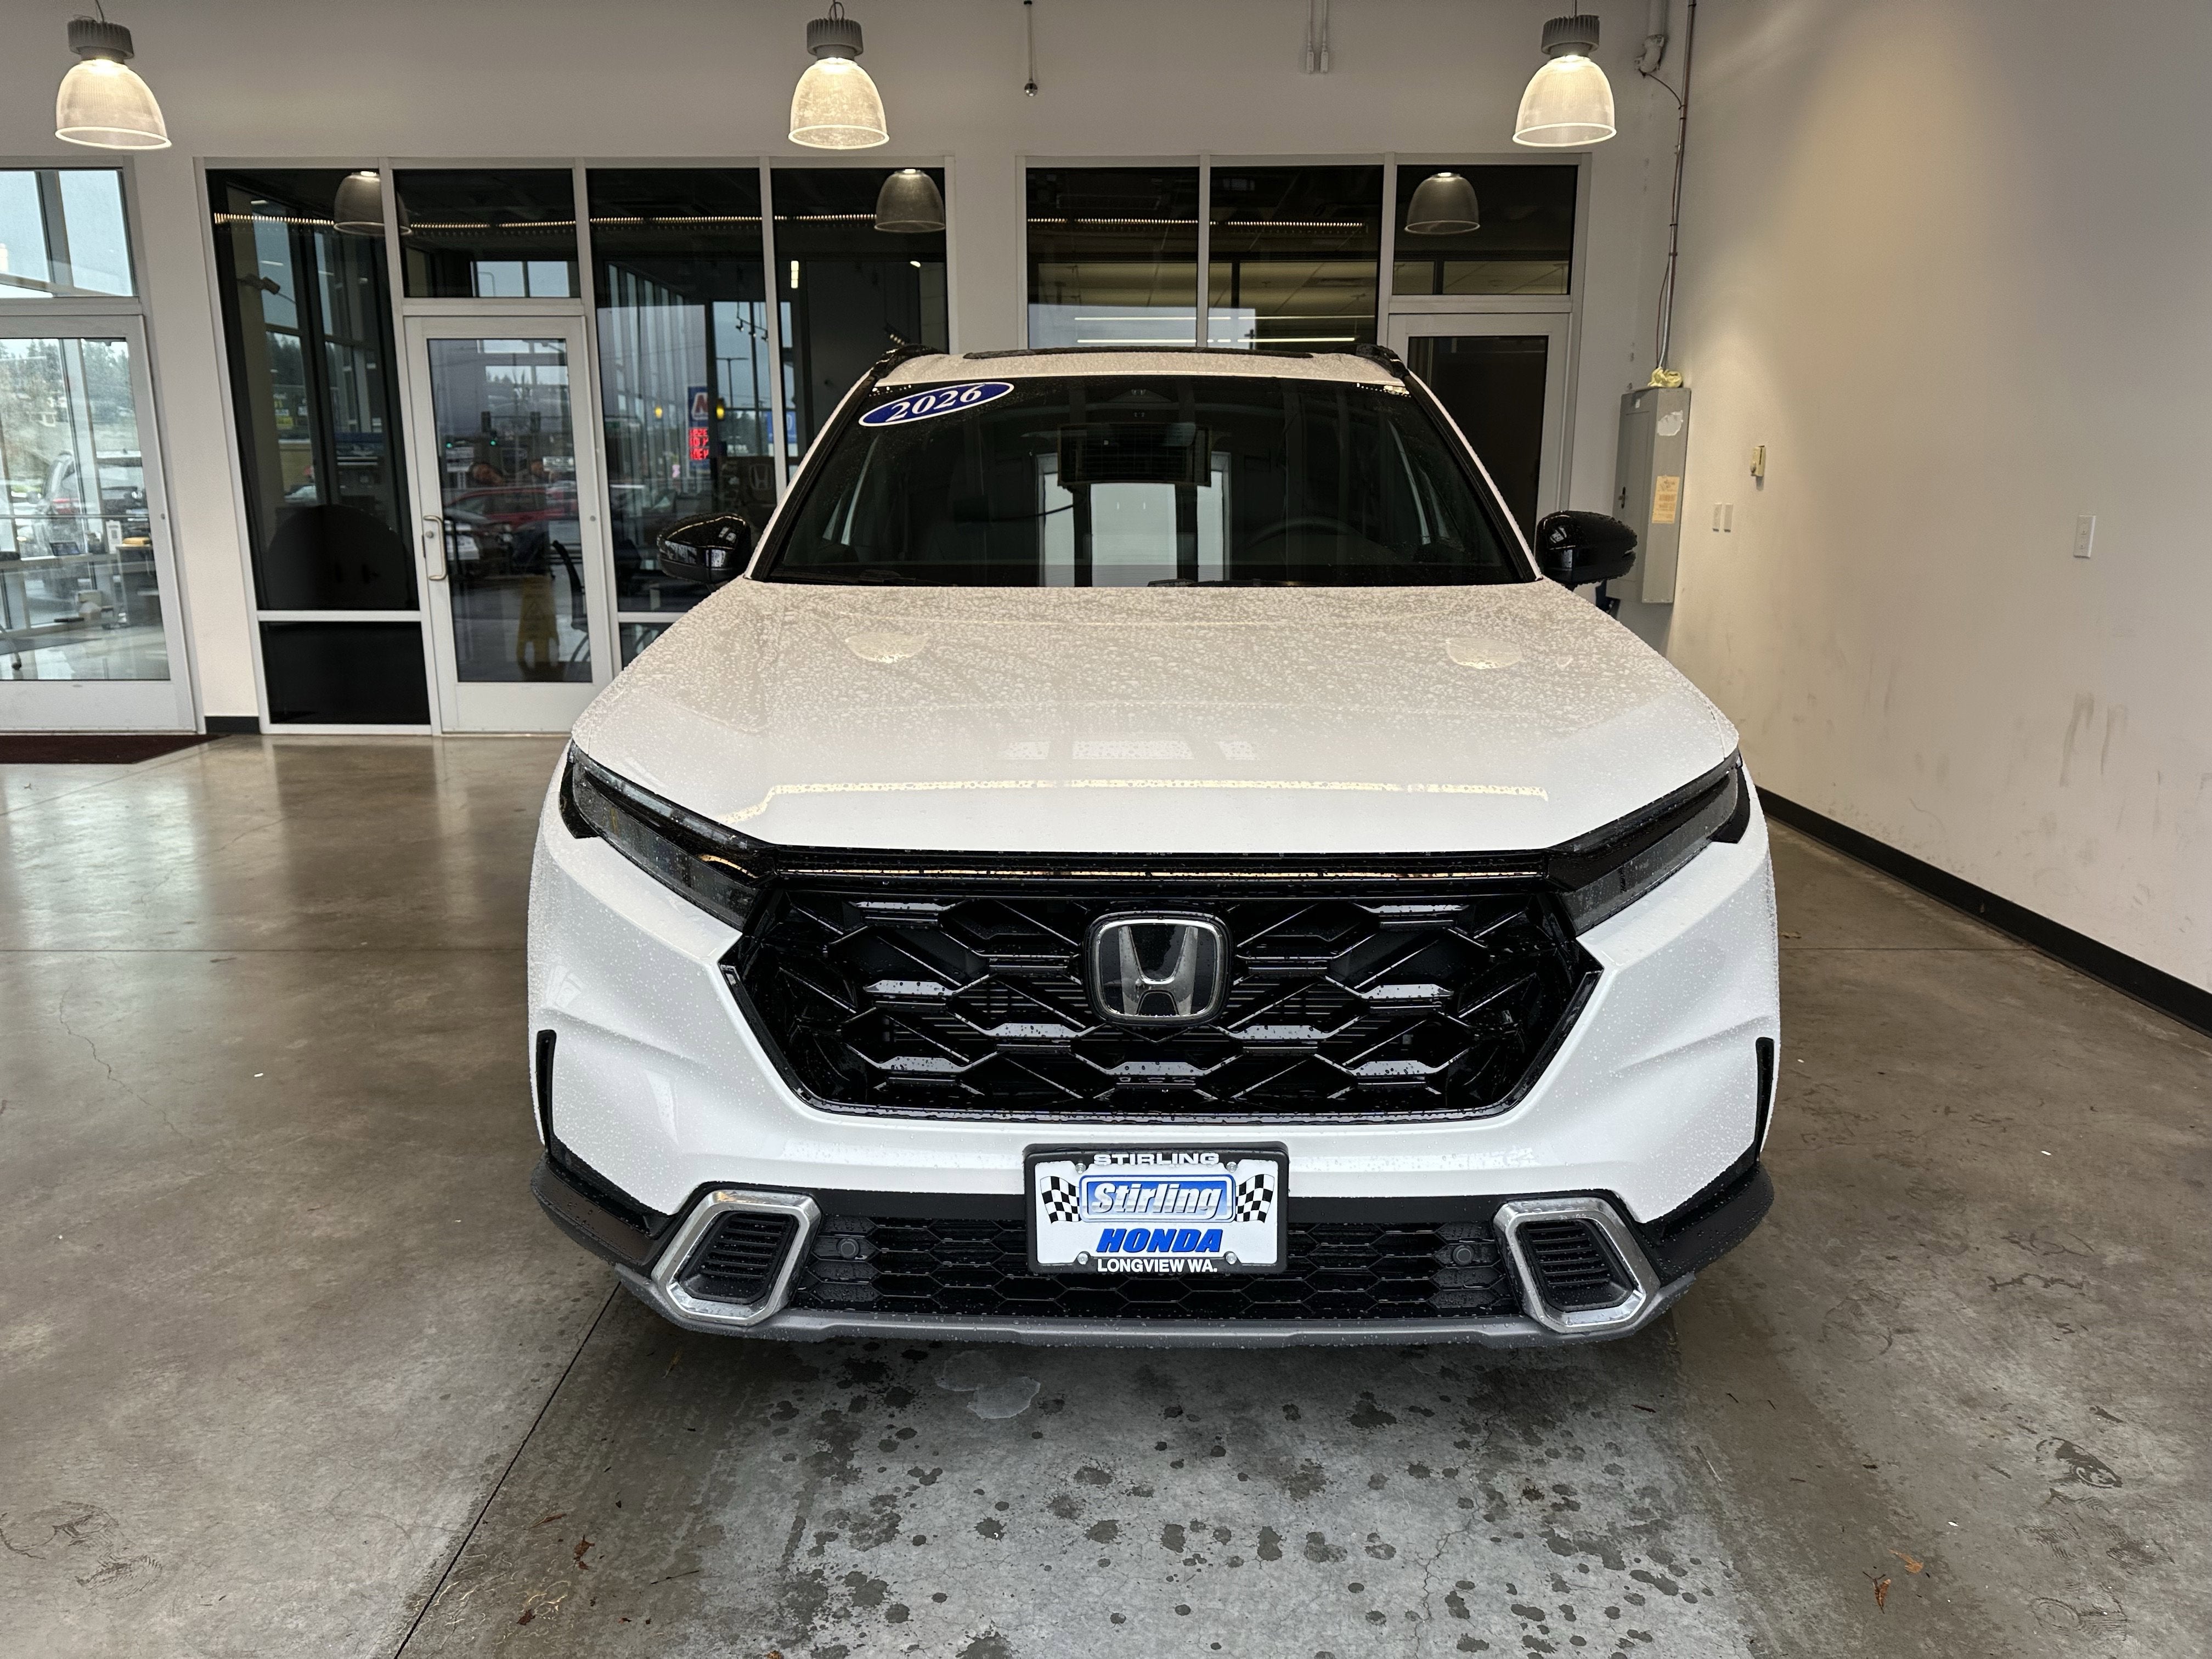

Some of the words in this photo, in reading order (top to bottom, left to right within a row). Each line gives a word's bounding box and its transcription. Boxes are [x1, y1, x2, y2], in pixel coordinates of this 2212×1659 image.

[885, 383, 986, 422] 2026
[1093, 1153, 1219, 1165] STIRLING
[1092, 1182, 1222, 1220] Stirling
[1096, 1228, 1223, 1252] HONDA
[1097, 1259, 1184, 1272] LONGVIEW
[1187, 1259, 1217, 1272] WA.
